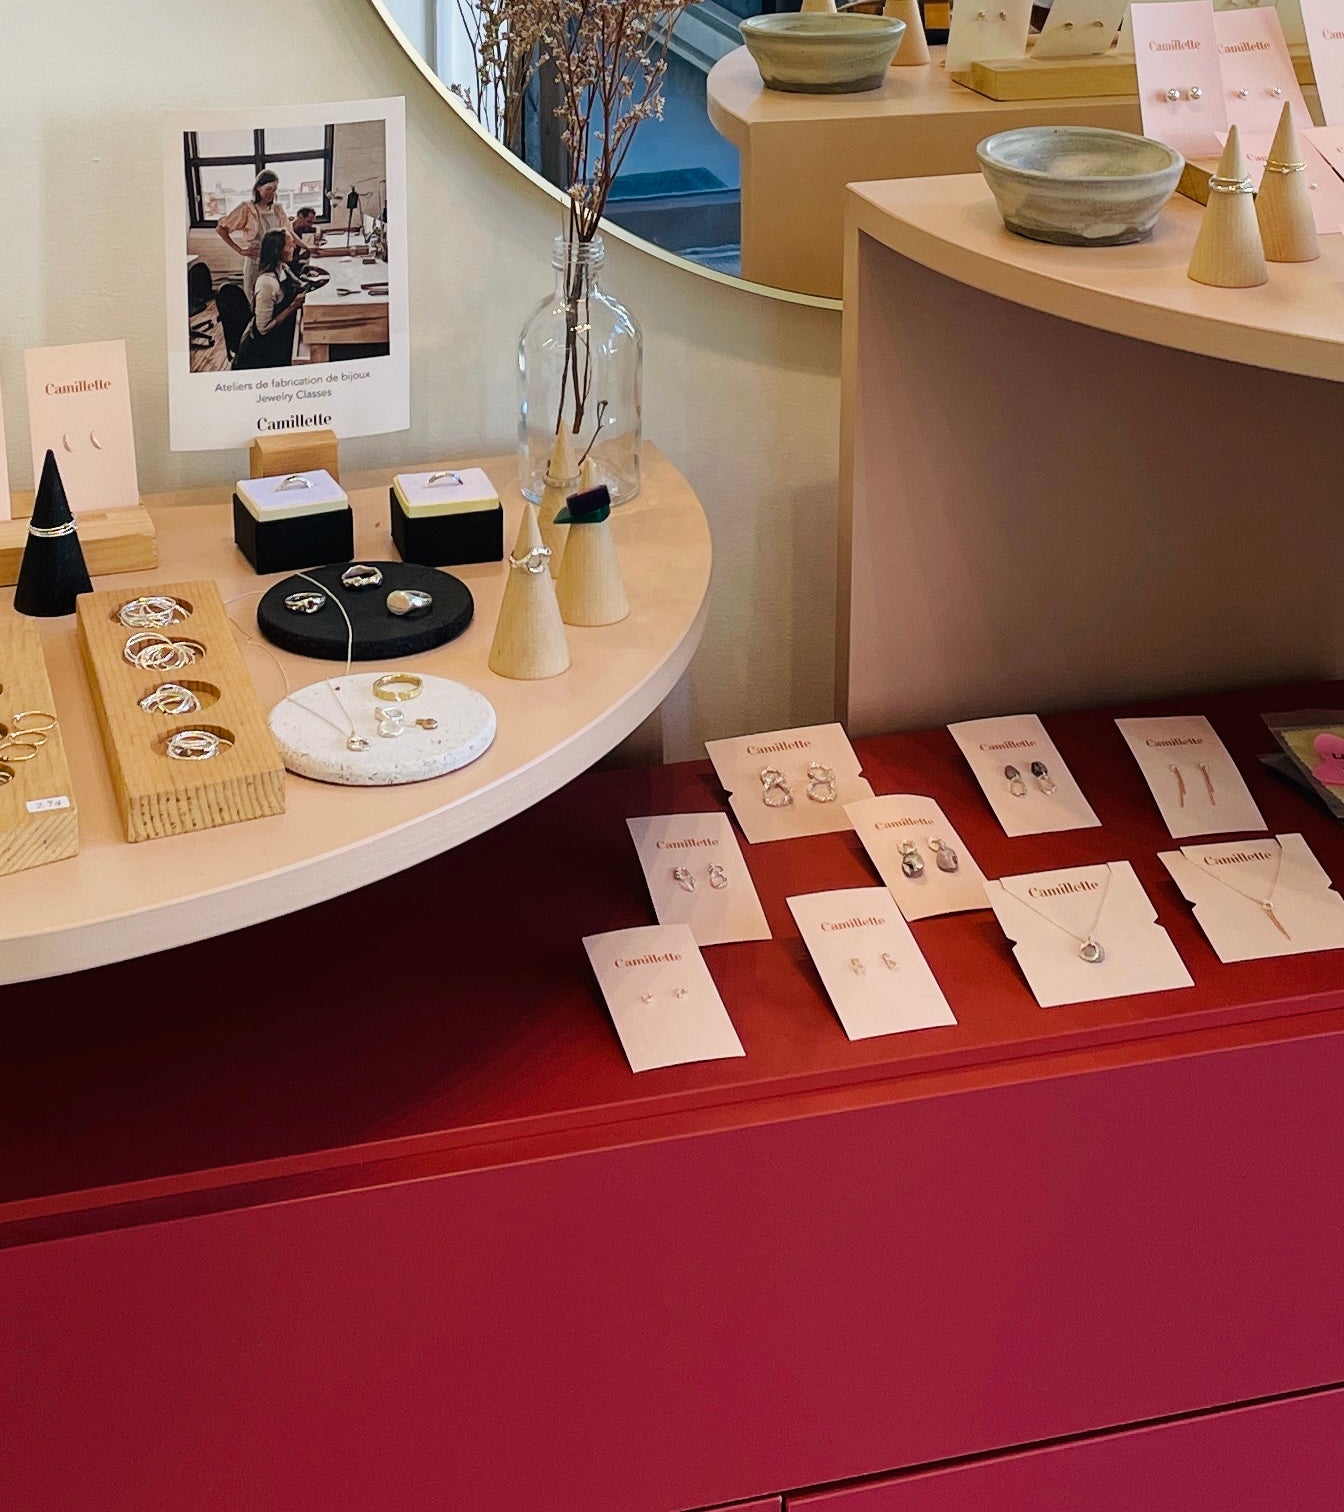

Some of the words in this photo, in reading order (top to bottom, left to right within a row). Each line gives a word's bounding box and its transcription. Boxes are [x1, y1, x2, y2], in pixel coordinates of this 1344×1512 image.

[1148, 39, 1201, 52] Camillette
[45, 379, 112, 396] Camillette
[215, 382, 253, 392] Ateliers
[256, 379, 269, 389] de
[272, 376, 323, 388] fabrication
[326, 373, 338, 383] de
[341, 371, 371, 383] bijoux
[256, 391, 294, 403] Jewelry
[296, 388, 332, 399] Classes
[257, 413, 332, 432] Camillette
[746, 740, 811, 755] Camillette
[979, 739, 1036, 751] Camillette
[1145, 737, 1204, 748] Camillette
[874, 817, 935, 830] Camillette
[655, 838, 720, 850] Camillette
[1203, 851, 1272, 866] Camillette
[1028, 881, 1099, 898] Camillette
[820, 917, 886, 932] Camillette
[614, 953, 683, 969] Camillette
